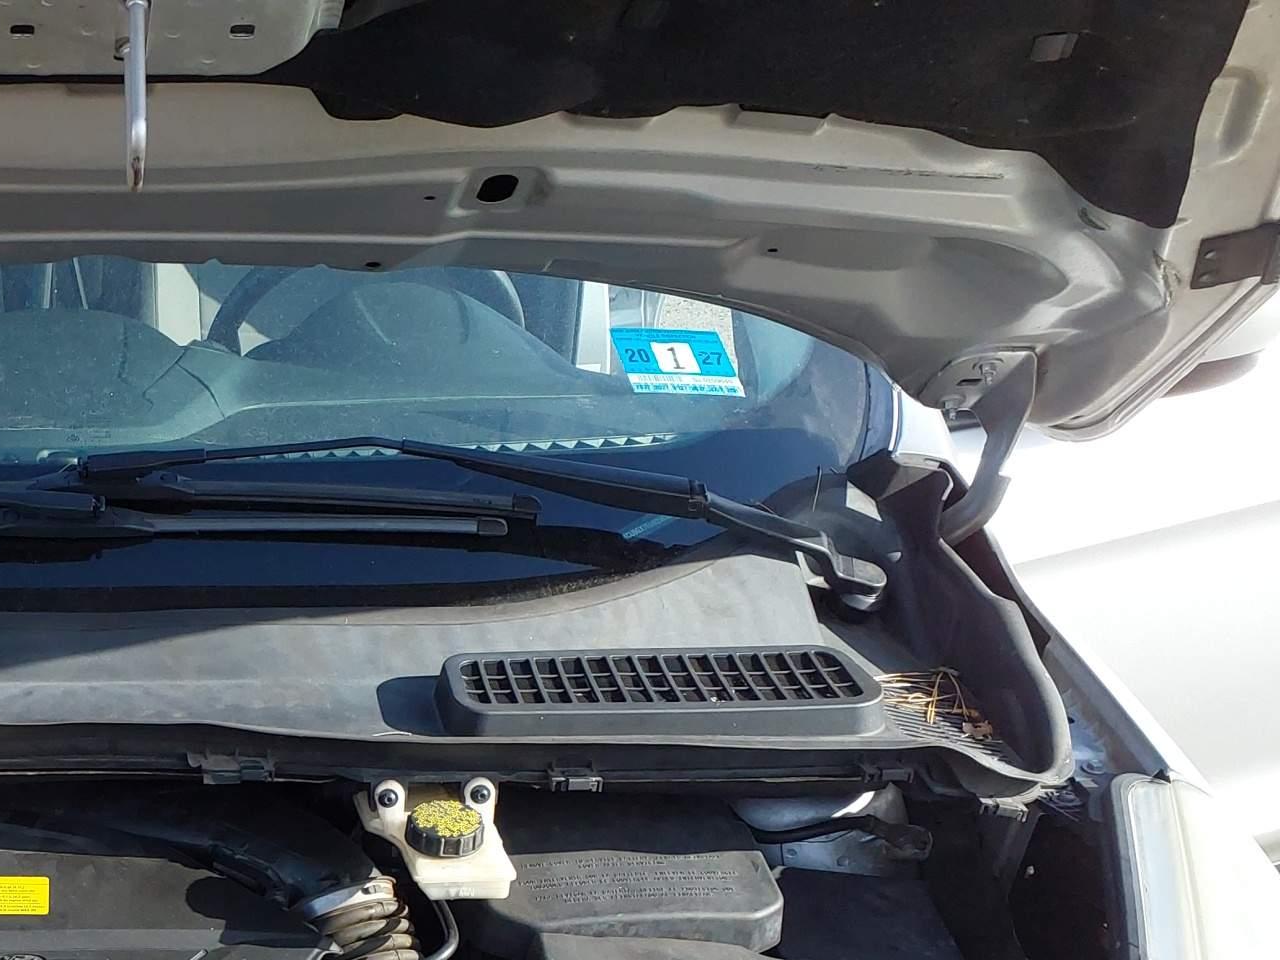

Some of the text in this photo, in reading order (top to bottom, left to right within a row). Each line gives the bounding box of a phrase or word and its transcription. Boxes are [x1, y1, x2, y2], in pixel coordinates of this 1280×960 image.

[625, 347, 722, 369] 20 1 27
